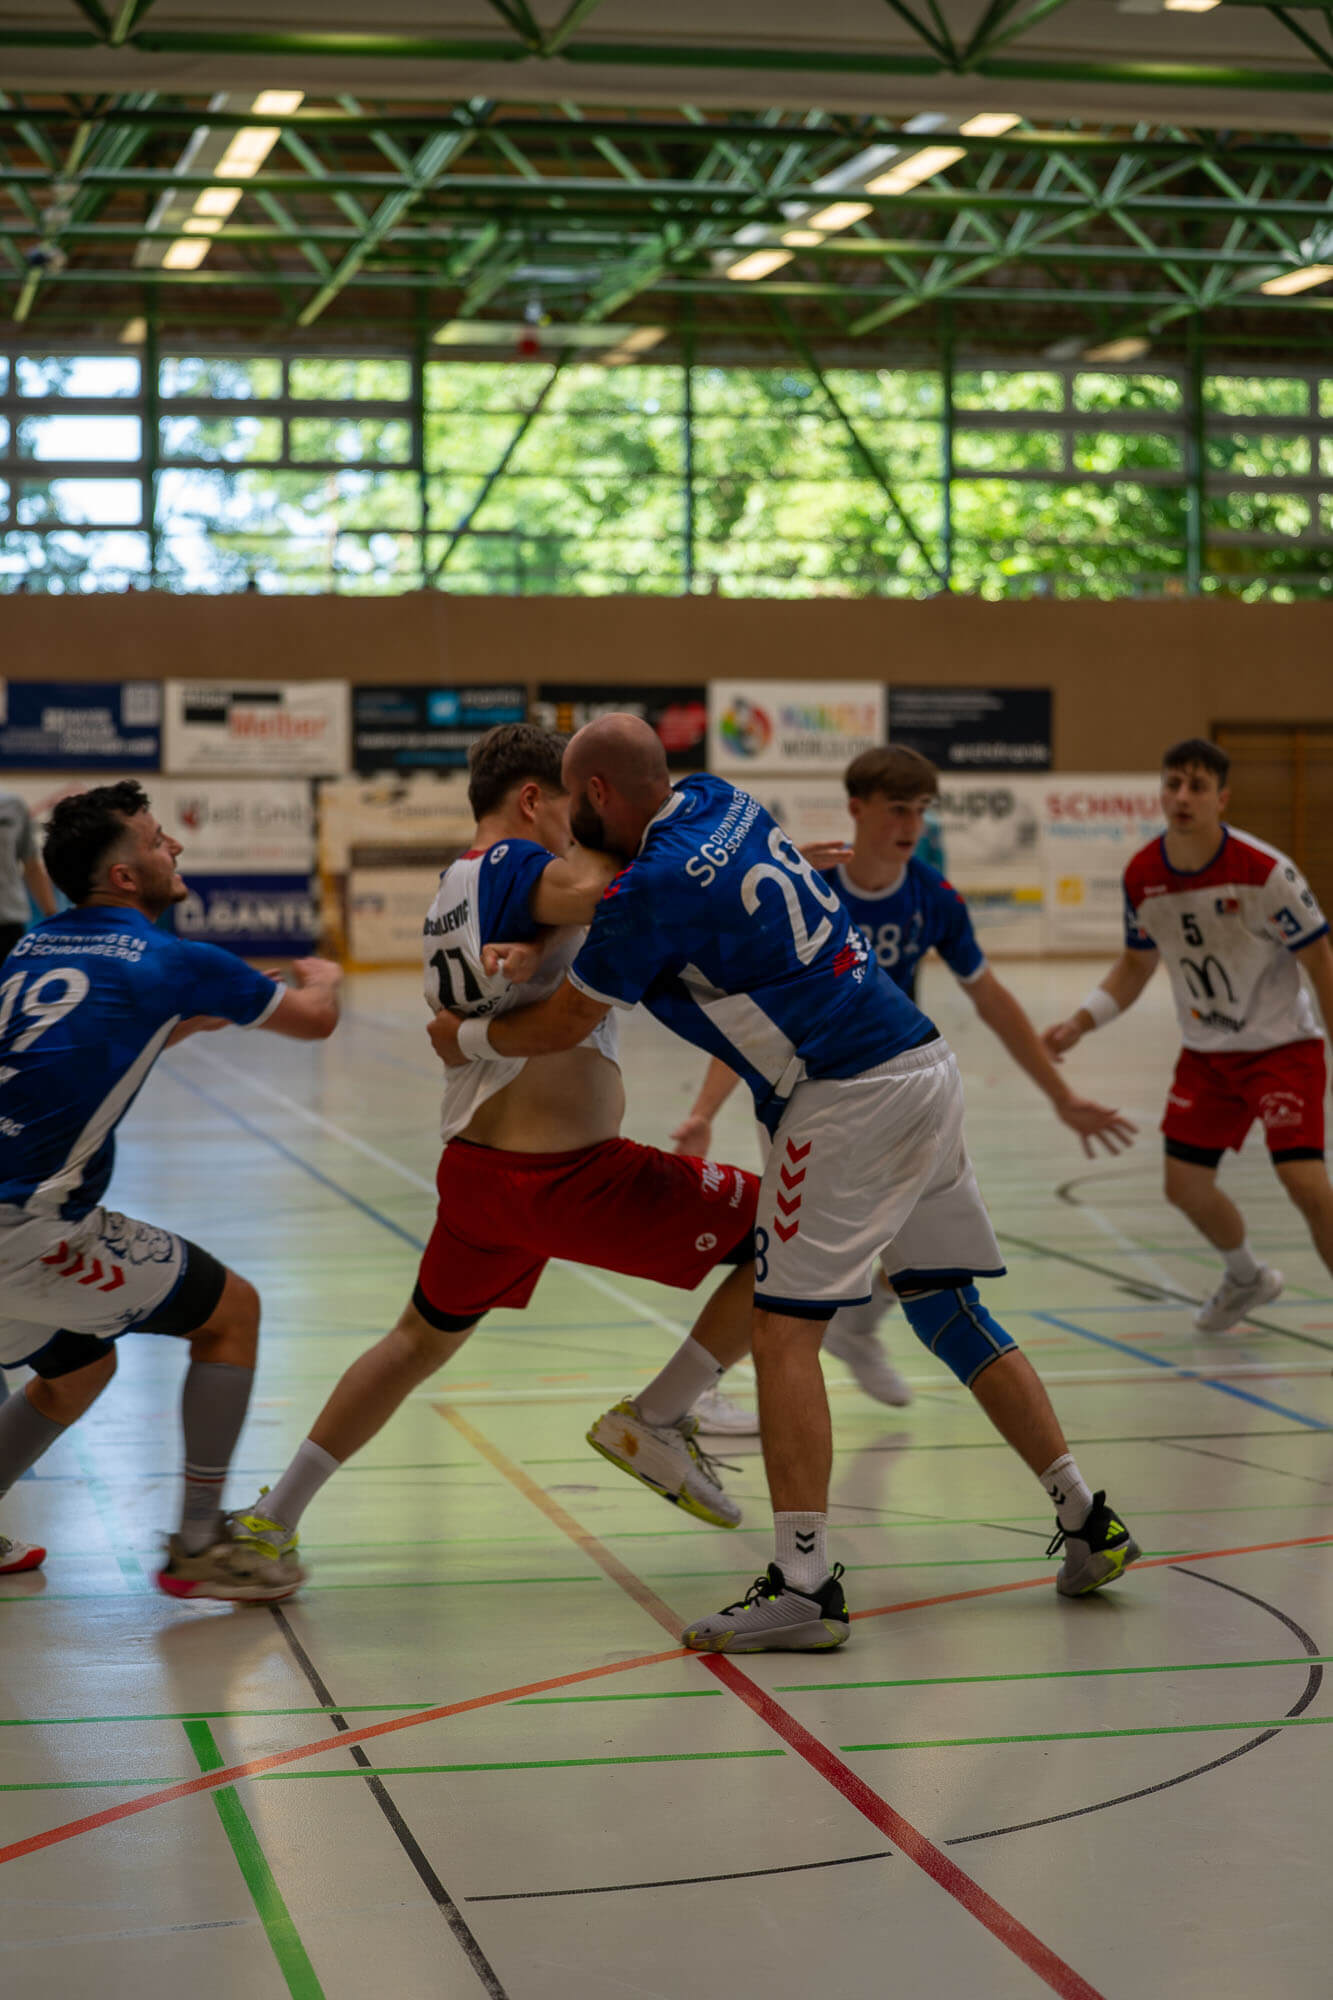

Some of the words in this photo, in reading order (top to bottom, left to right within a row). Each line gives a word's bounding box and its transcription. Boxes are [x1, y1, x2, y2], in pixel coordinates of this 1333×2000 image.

[685, 843, 729, 888] SG
[740, 826, 841, 965] 28
[36, 932, 147, 951] DUNNINGEN
[1181, 913, 1203, 946] 5
[30, 944, 142, 962] SCHRAMBERG
[0, 967, 90, 1052] 19
